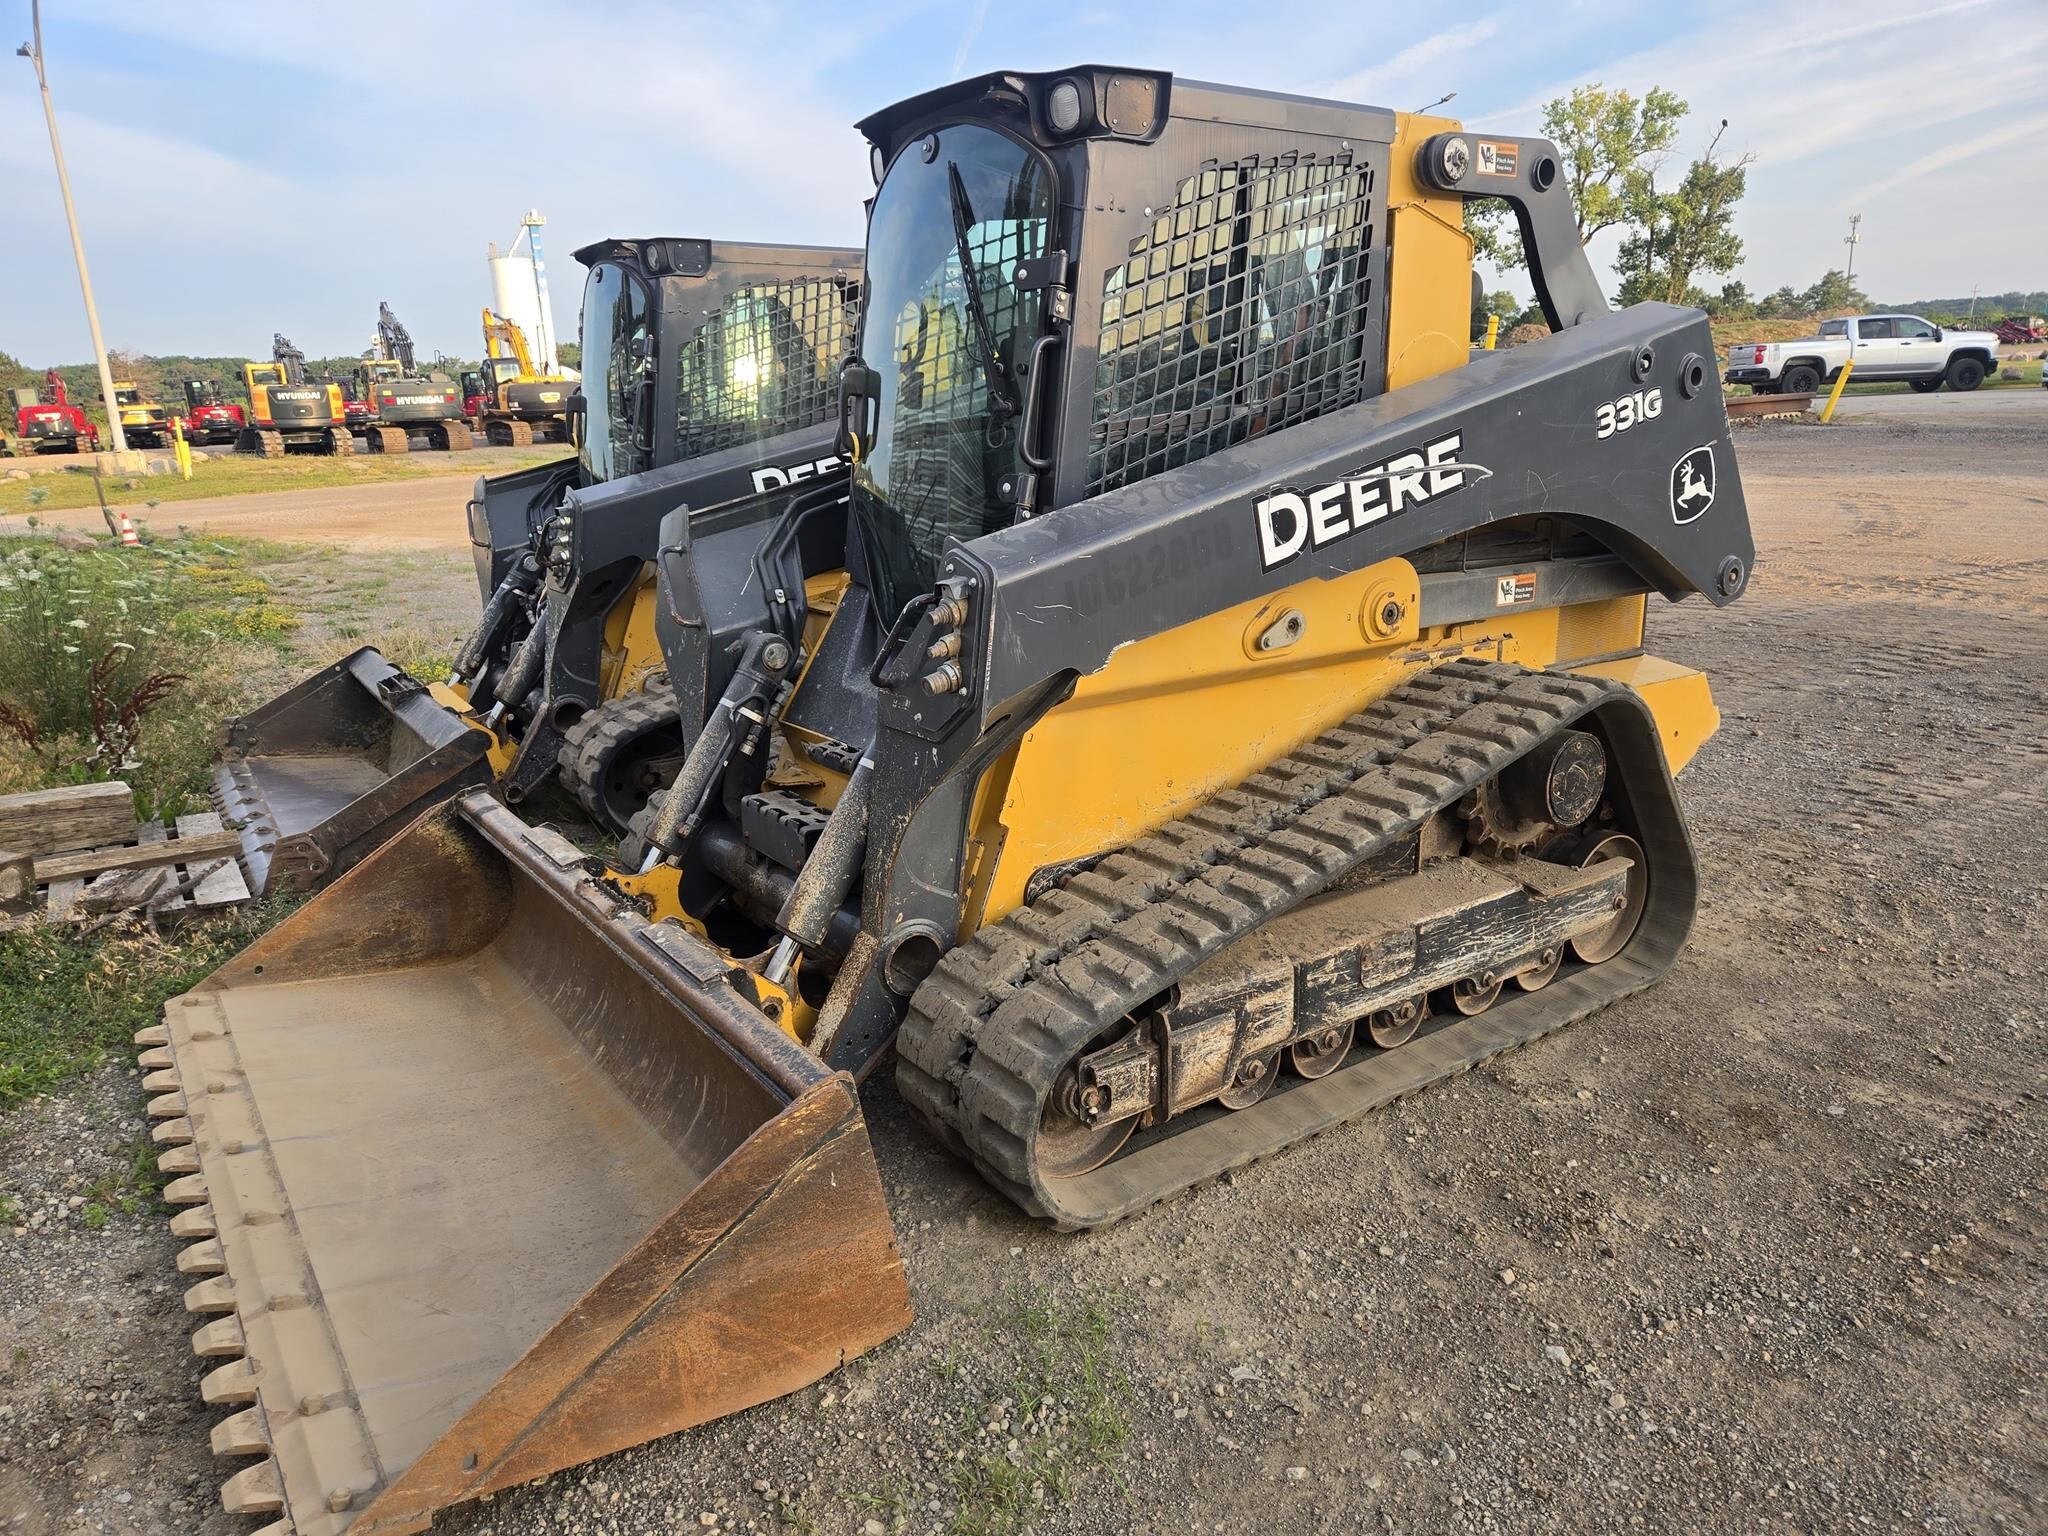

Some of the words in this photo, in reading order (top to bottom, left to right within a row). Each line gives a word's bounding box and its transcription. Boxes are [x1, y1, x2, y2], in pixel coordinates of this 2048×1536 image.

[277, 391, 321, 400] HYUNDAI
[396, 395, 445, 406] HYUNDAI
[1596, 388, 1663, 439] 331G
[1256, 434, 1464, 567] DEERE
